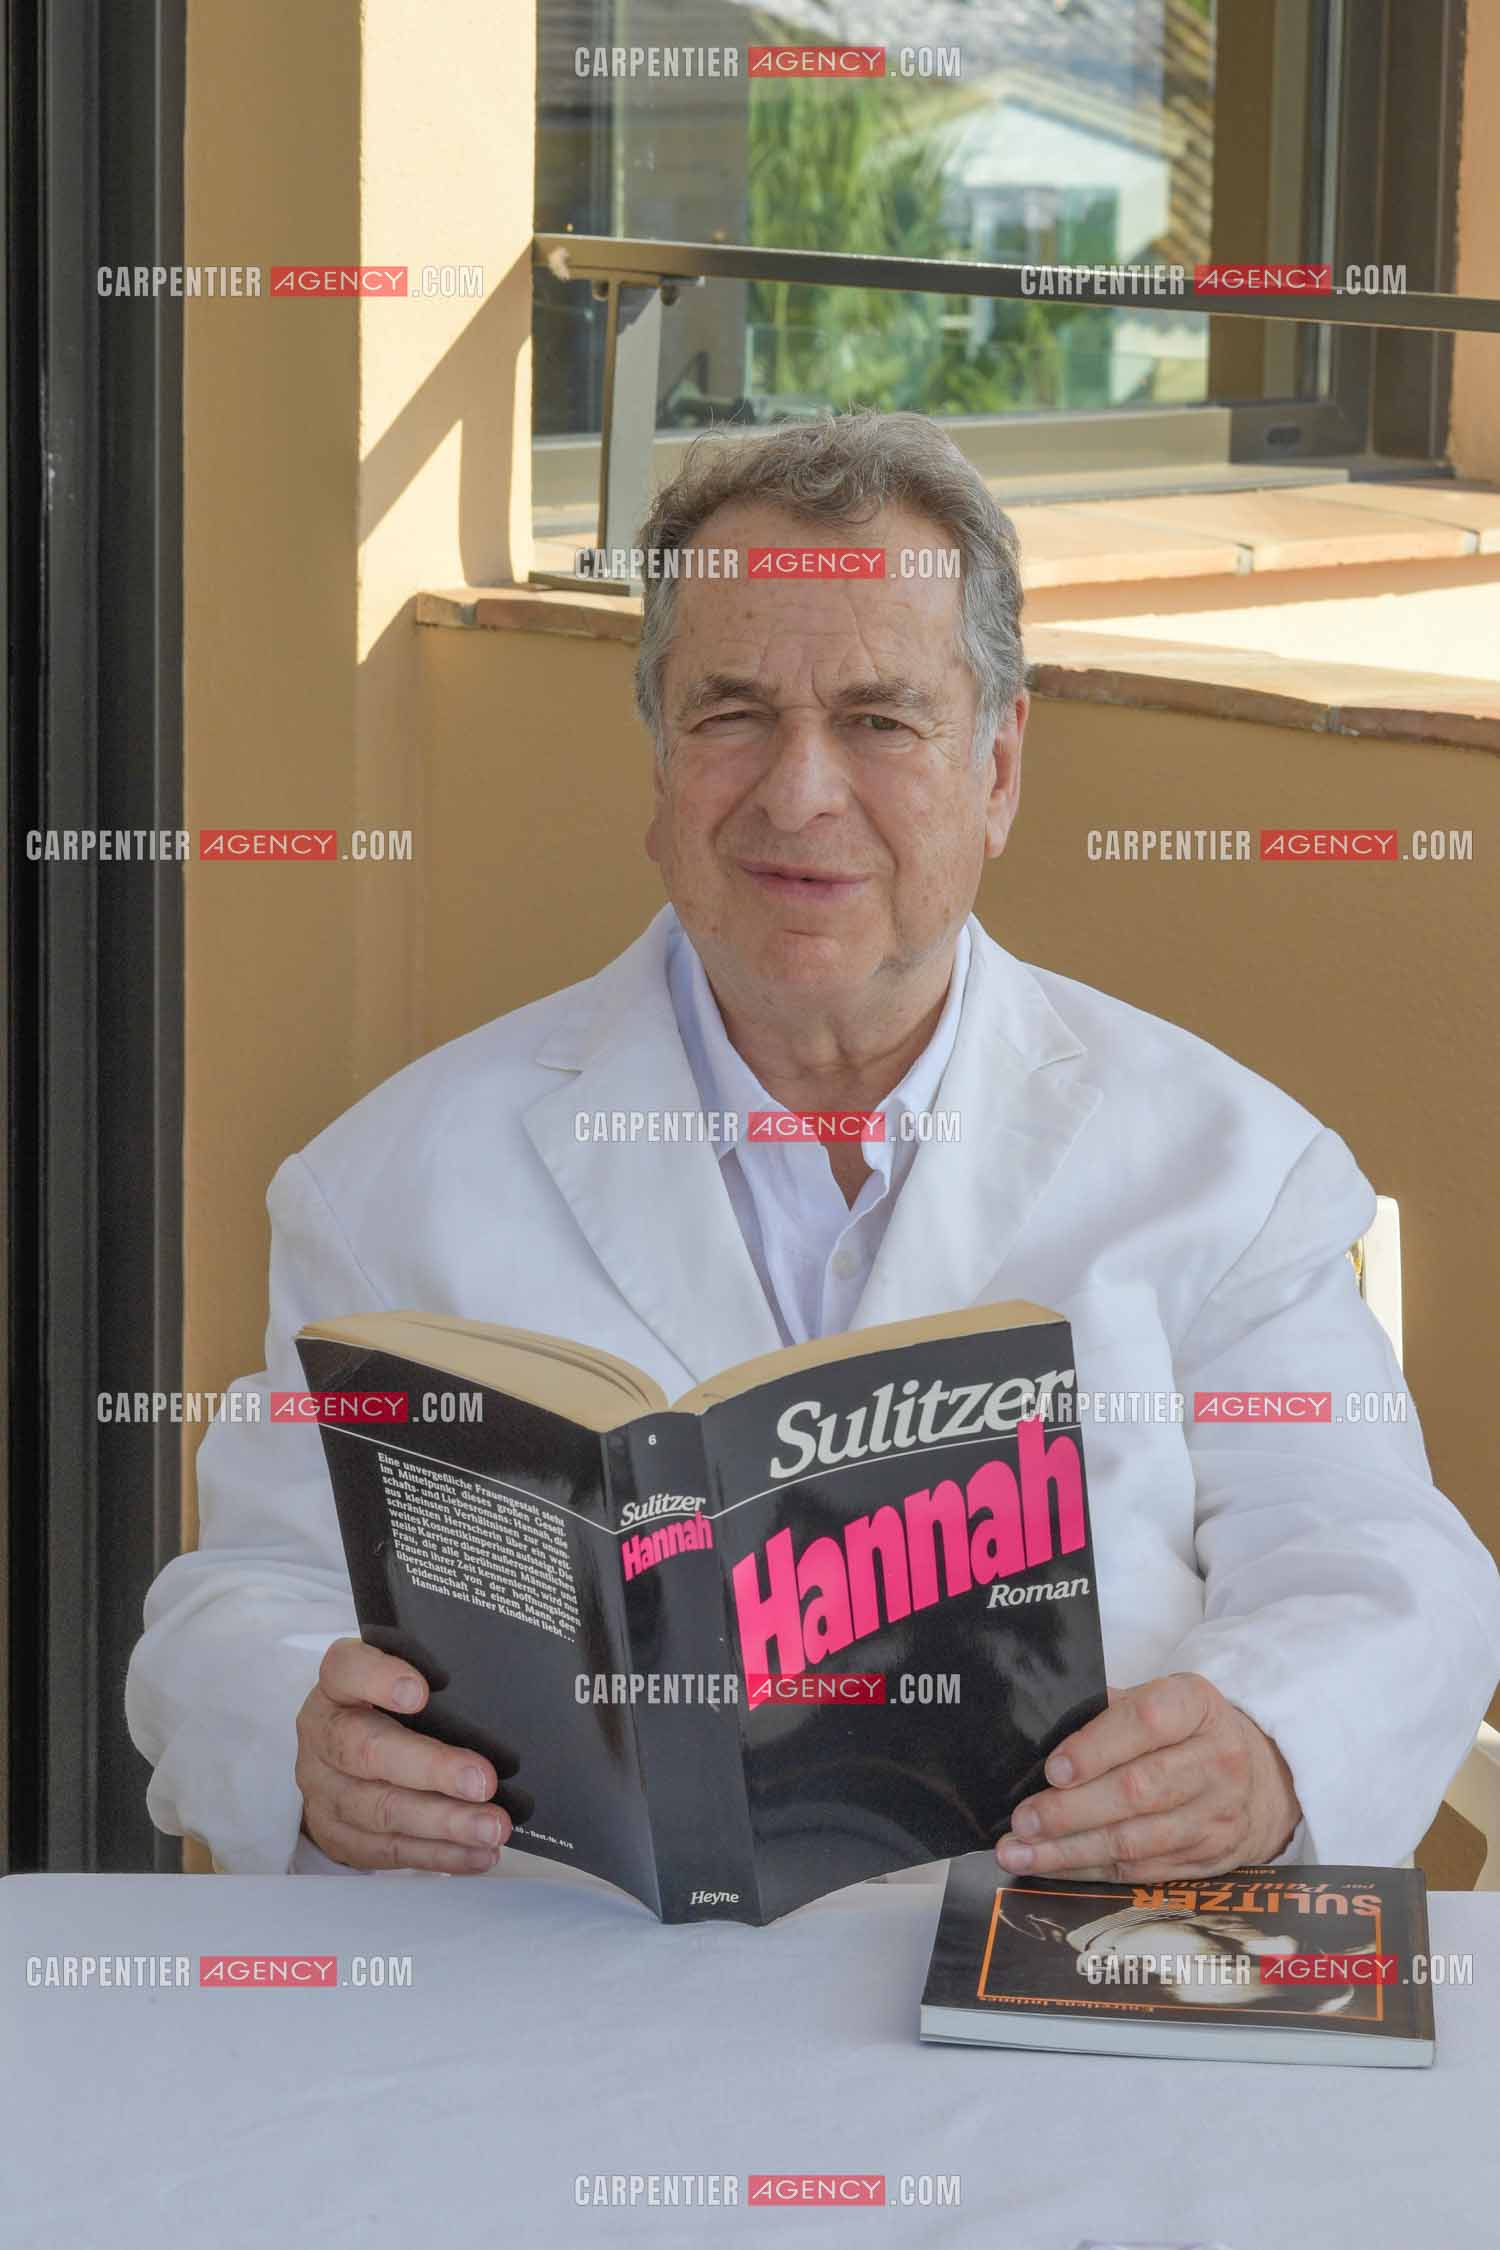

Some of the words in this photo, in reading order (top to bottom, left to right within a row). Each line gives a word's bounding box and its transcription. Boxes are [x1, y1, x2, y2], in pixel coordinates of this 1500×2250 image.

[648, 1434, 657, 1446] 6
[770, 1368, 1076, 1480] Sulitzer
[620, 1493, 706, 1526] Sulitzer
[622, 1510, 713, 1582] Hannah
[732, 1414, 1086, 1711] Hannah
[987, 1576, 1090, 1609] Roman
[690, 1890, 740, 1906] Heyne
[1130, 1888, 1383, 1917] SULITZER
